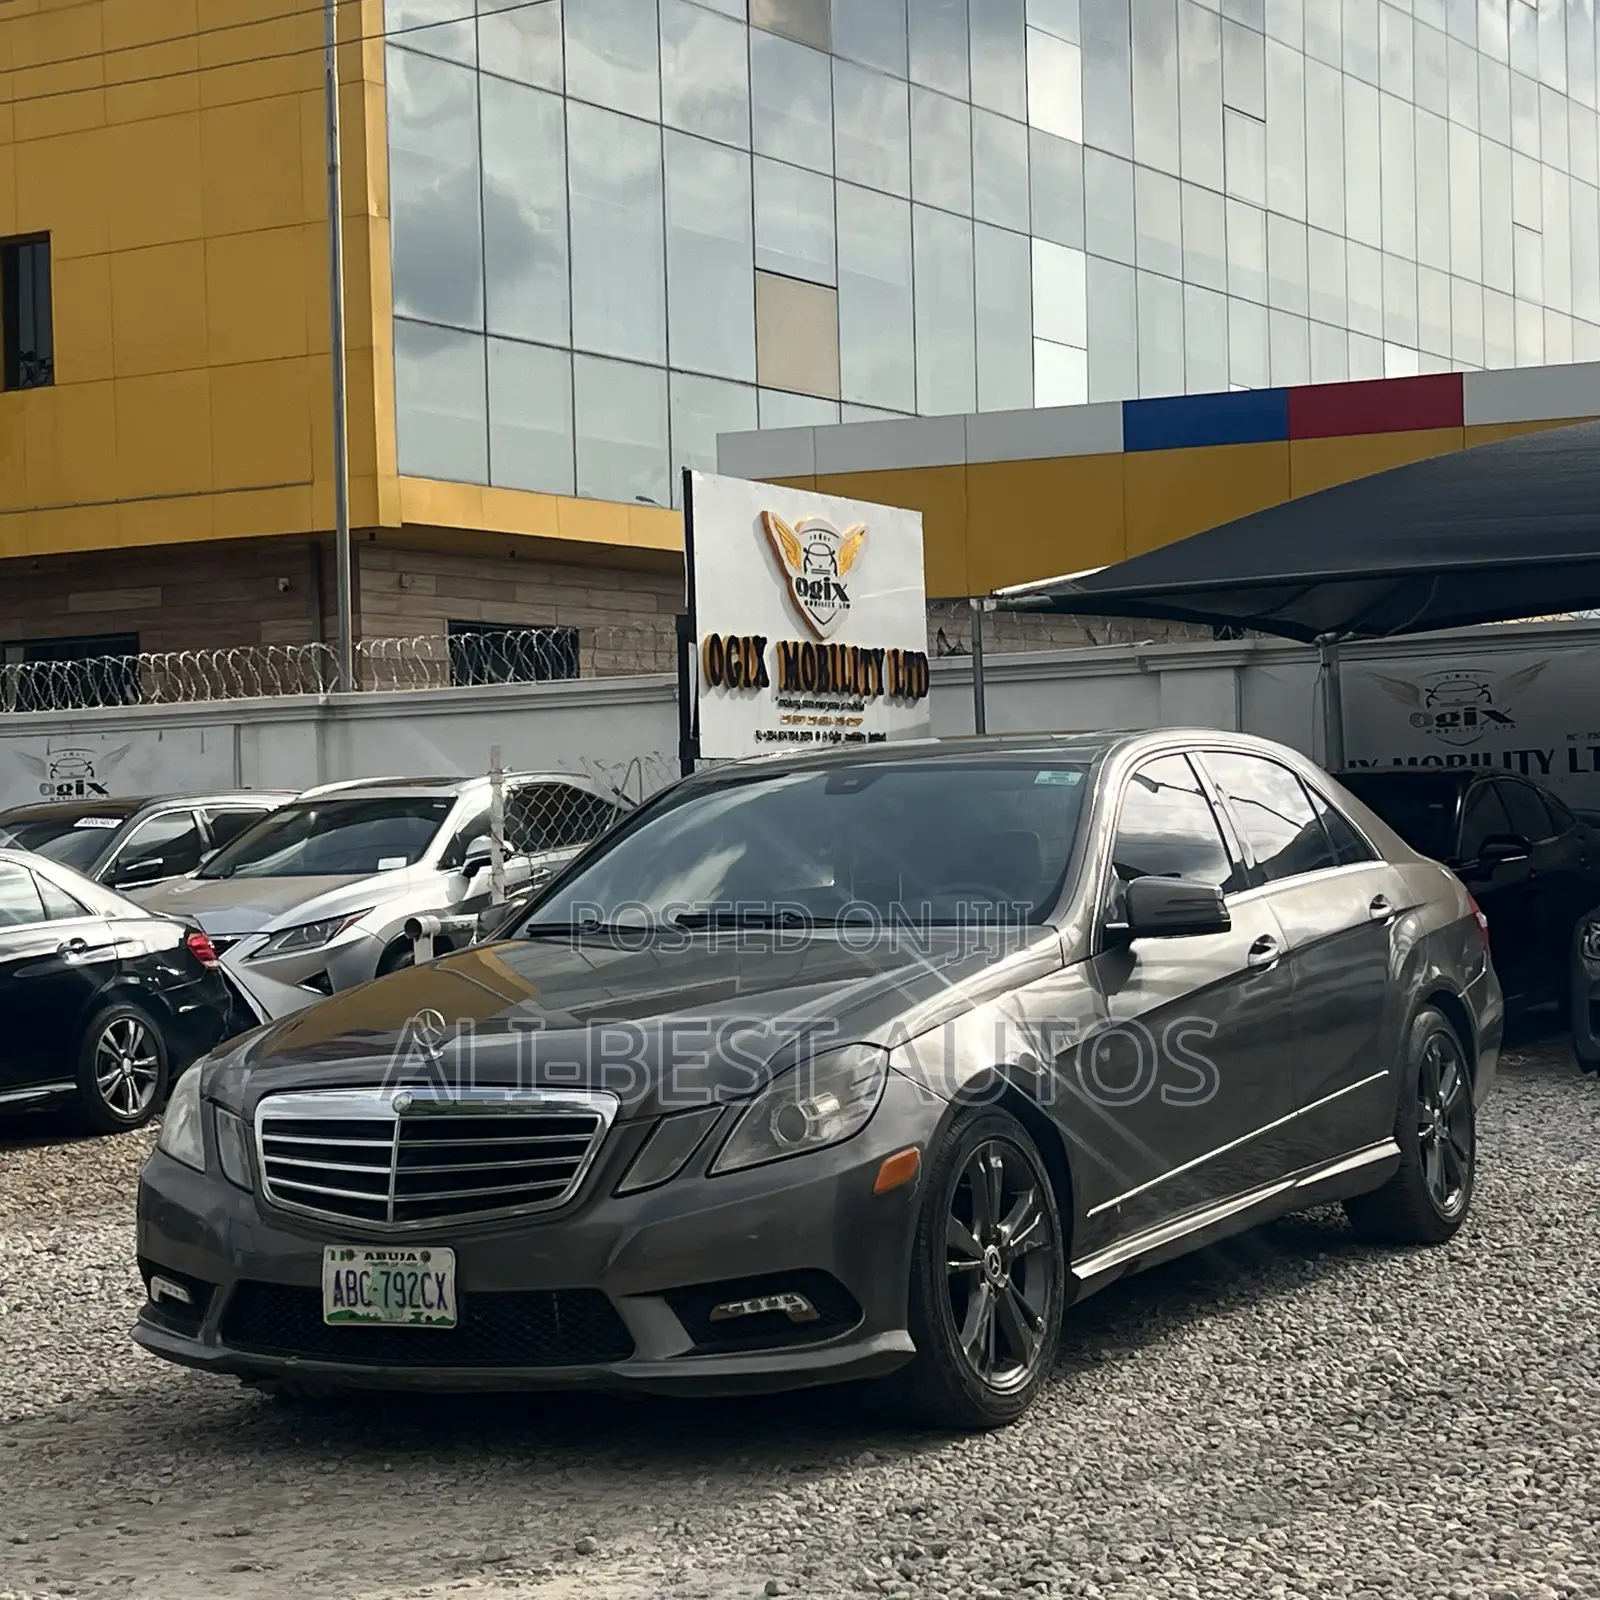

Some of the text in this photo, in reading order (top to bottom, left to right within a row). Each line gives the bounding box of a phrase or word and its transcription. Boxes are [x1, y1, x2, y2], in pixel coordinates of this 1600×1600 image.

[703, 633, 929, 697] OGIX MOBILITY LTD
[364, 1252, 418, 1261] ABUJA
